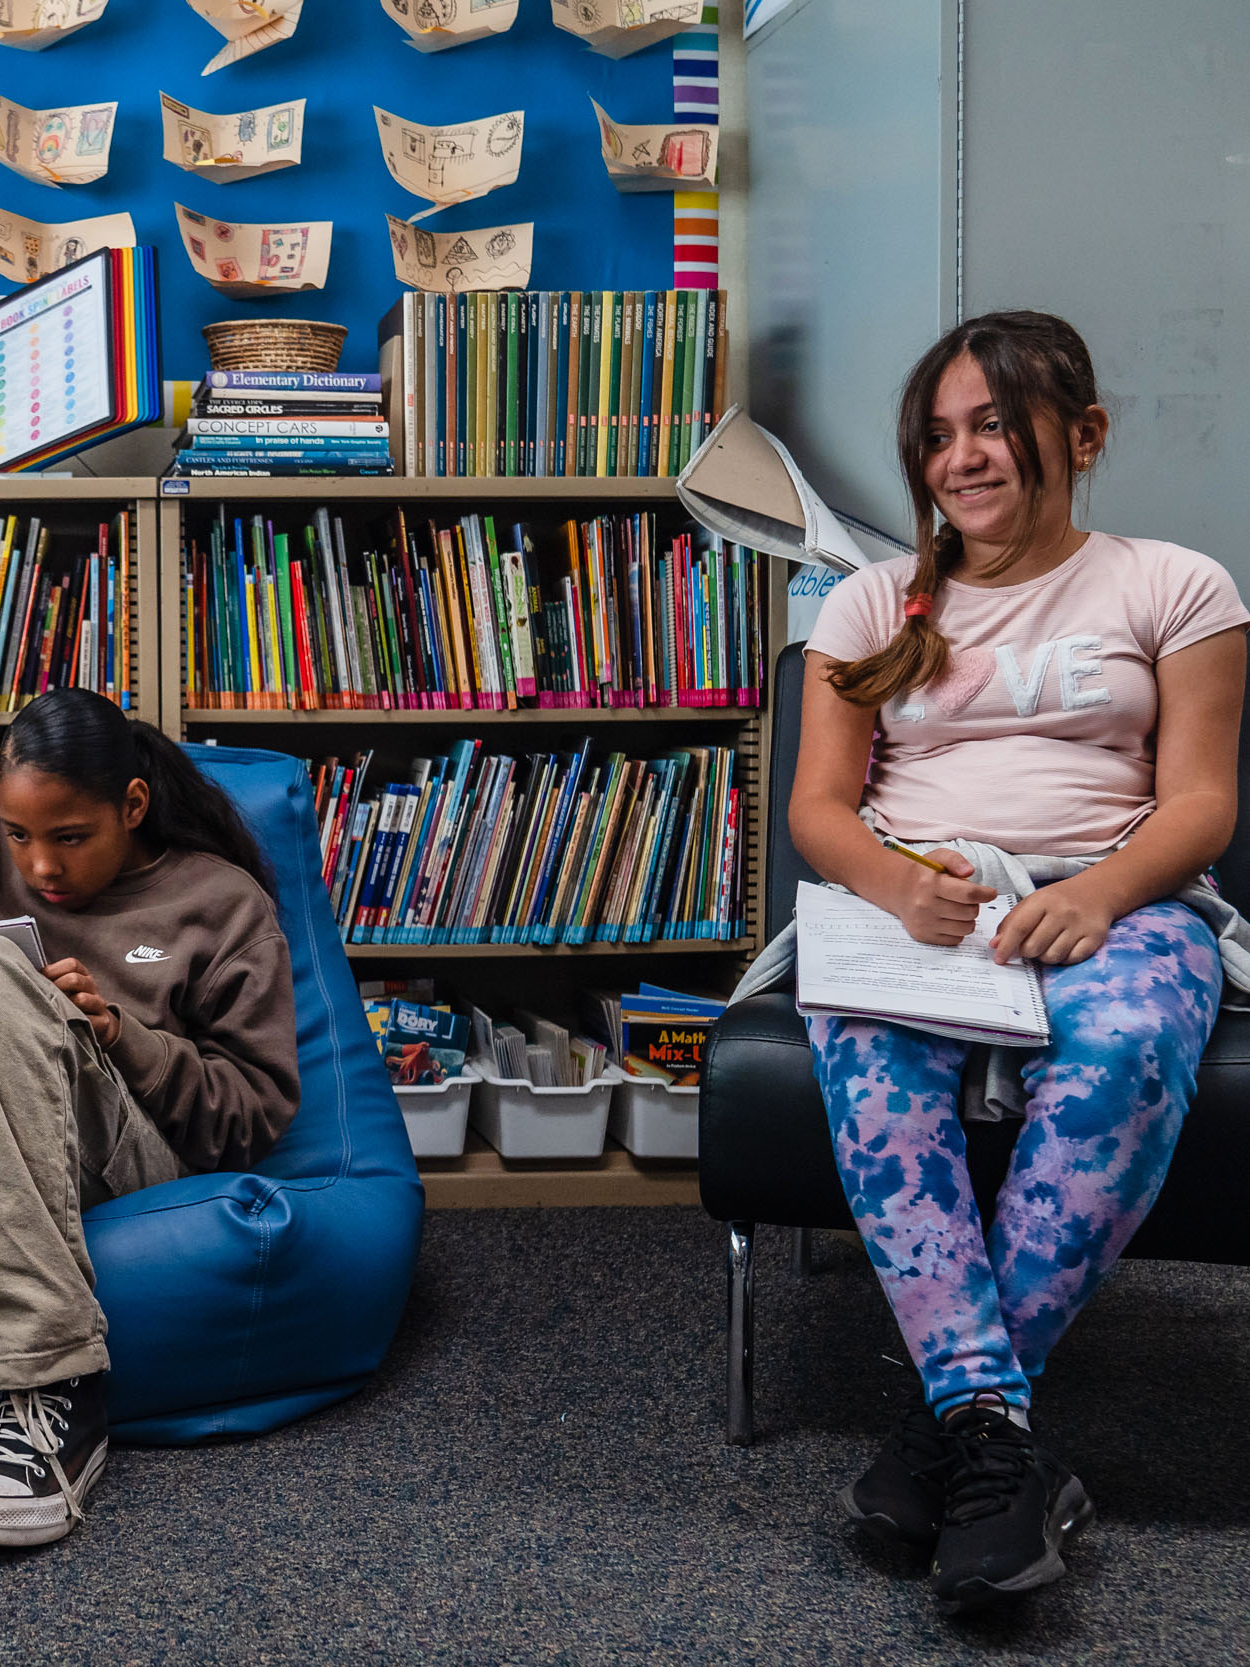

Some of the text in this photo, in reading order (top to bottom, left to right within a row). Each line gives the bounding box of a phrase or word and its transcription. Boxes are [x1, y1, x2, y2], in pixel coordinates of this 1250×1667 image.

[0, 309, 25, 330] BOOK
[55, 275, 89, 300] LABELS
[706, 338, 714, 357] GUIDE
[232, 373, 366, 389] Elementary Dictionary
[206, 405, 283, 414] SACRED CIRCLES
[198, 420, 317, 434] CONCEPT CARS
[265, 437, 289, 445] praise
[493, 568, 502, 591] Wildlife
[417, 587, 425, 609] COYOTES
[495, 592, 506, 622] Gardening
[504, 656, 512, 679] MARTYN
[654, 808, 676, 893] Civil War Kids
[133, 945, 164, 958] NIKE
[397, 1012, 438, 1032] DORY
[659, 1030, 706, 1044] A Math
